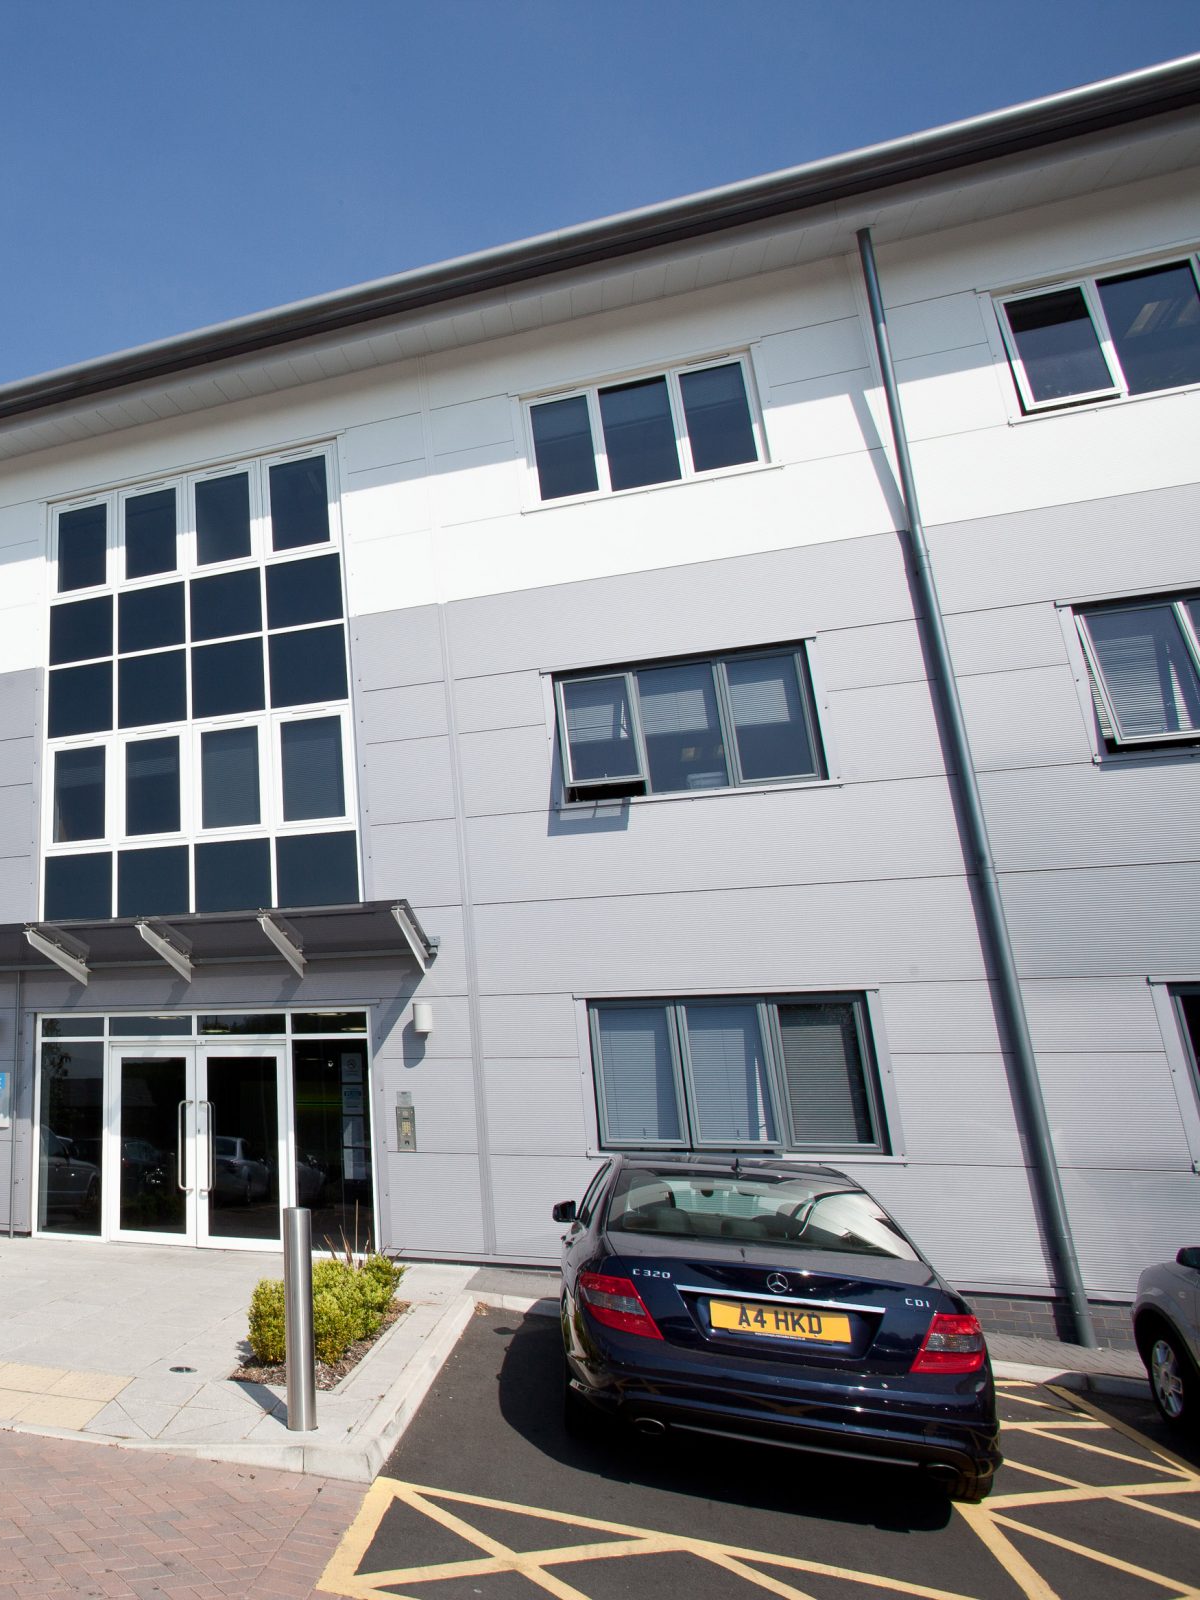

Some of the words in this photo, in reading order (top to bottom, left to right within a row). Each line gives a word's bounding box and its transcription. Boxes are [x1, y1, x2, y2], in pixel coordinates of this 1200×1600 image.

[905, 1298, 930, 1308] CDI
[738, 1304, 767, 1329] A4
[773, 1310, 823, 1336] HKD
